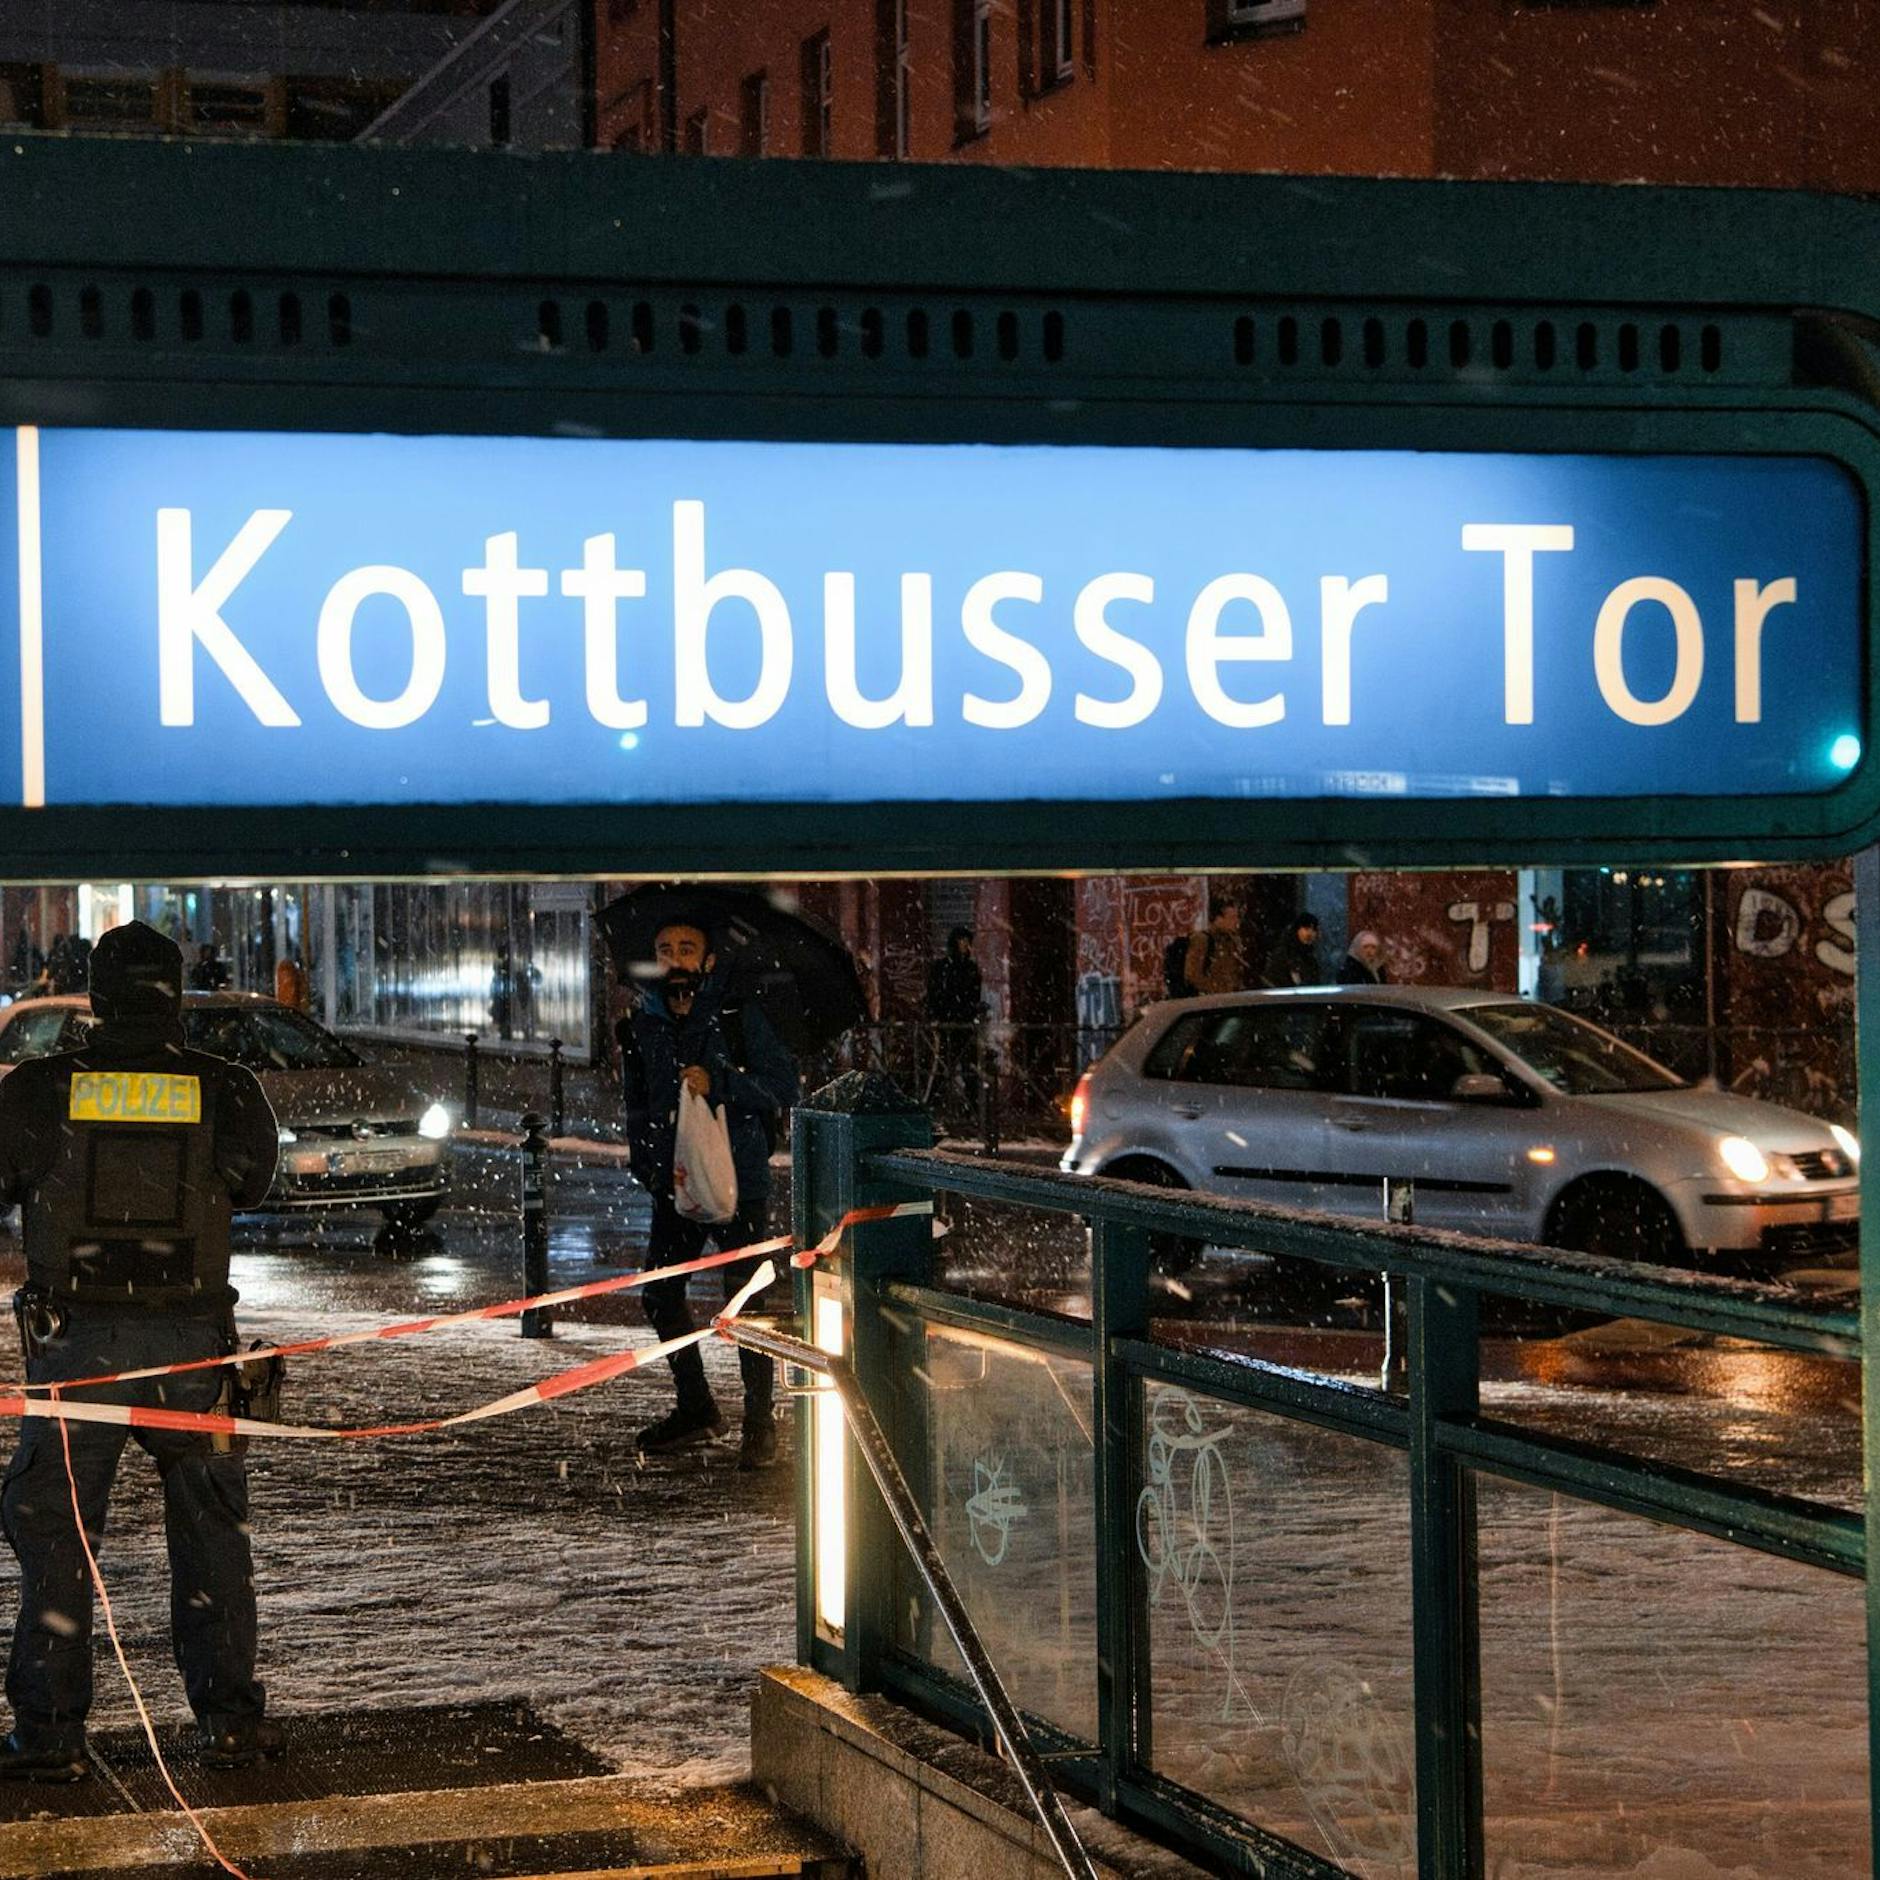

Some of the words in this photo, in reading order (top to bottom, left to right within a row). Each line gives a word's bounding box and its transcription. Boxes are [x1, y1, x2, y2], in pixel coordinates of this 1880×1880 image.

[157, 500, 1388, 729] Kottbusser
[1462, 524, 1797, 727] Tor
[73, 1076, 195, 1118] POLIZEI
